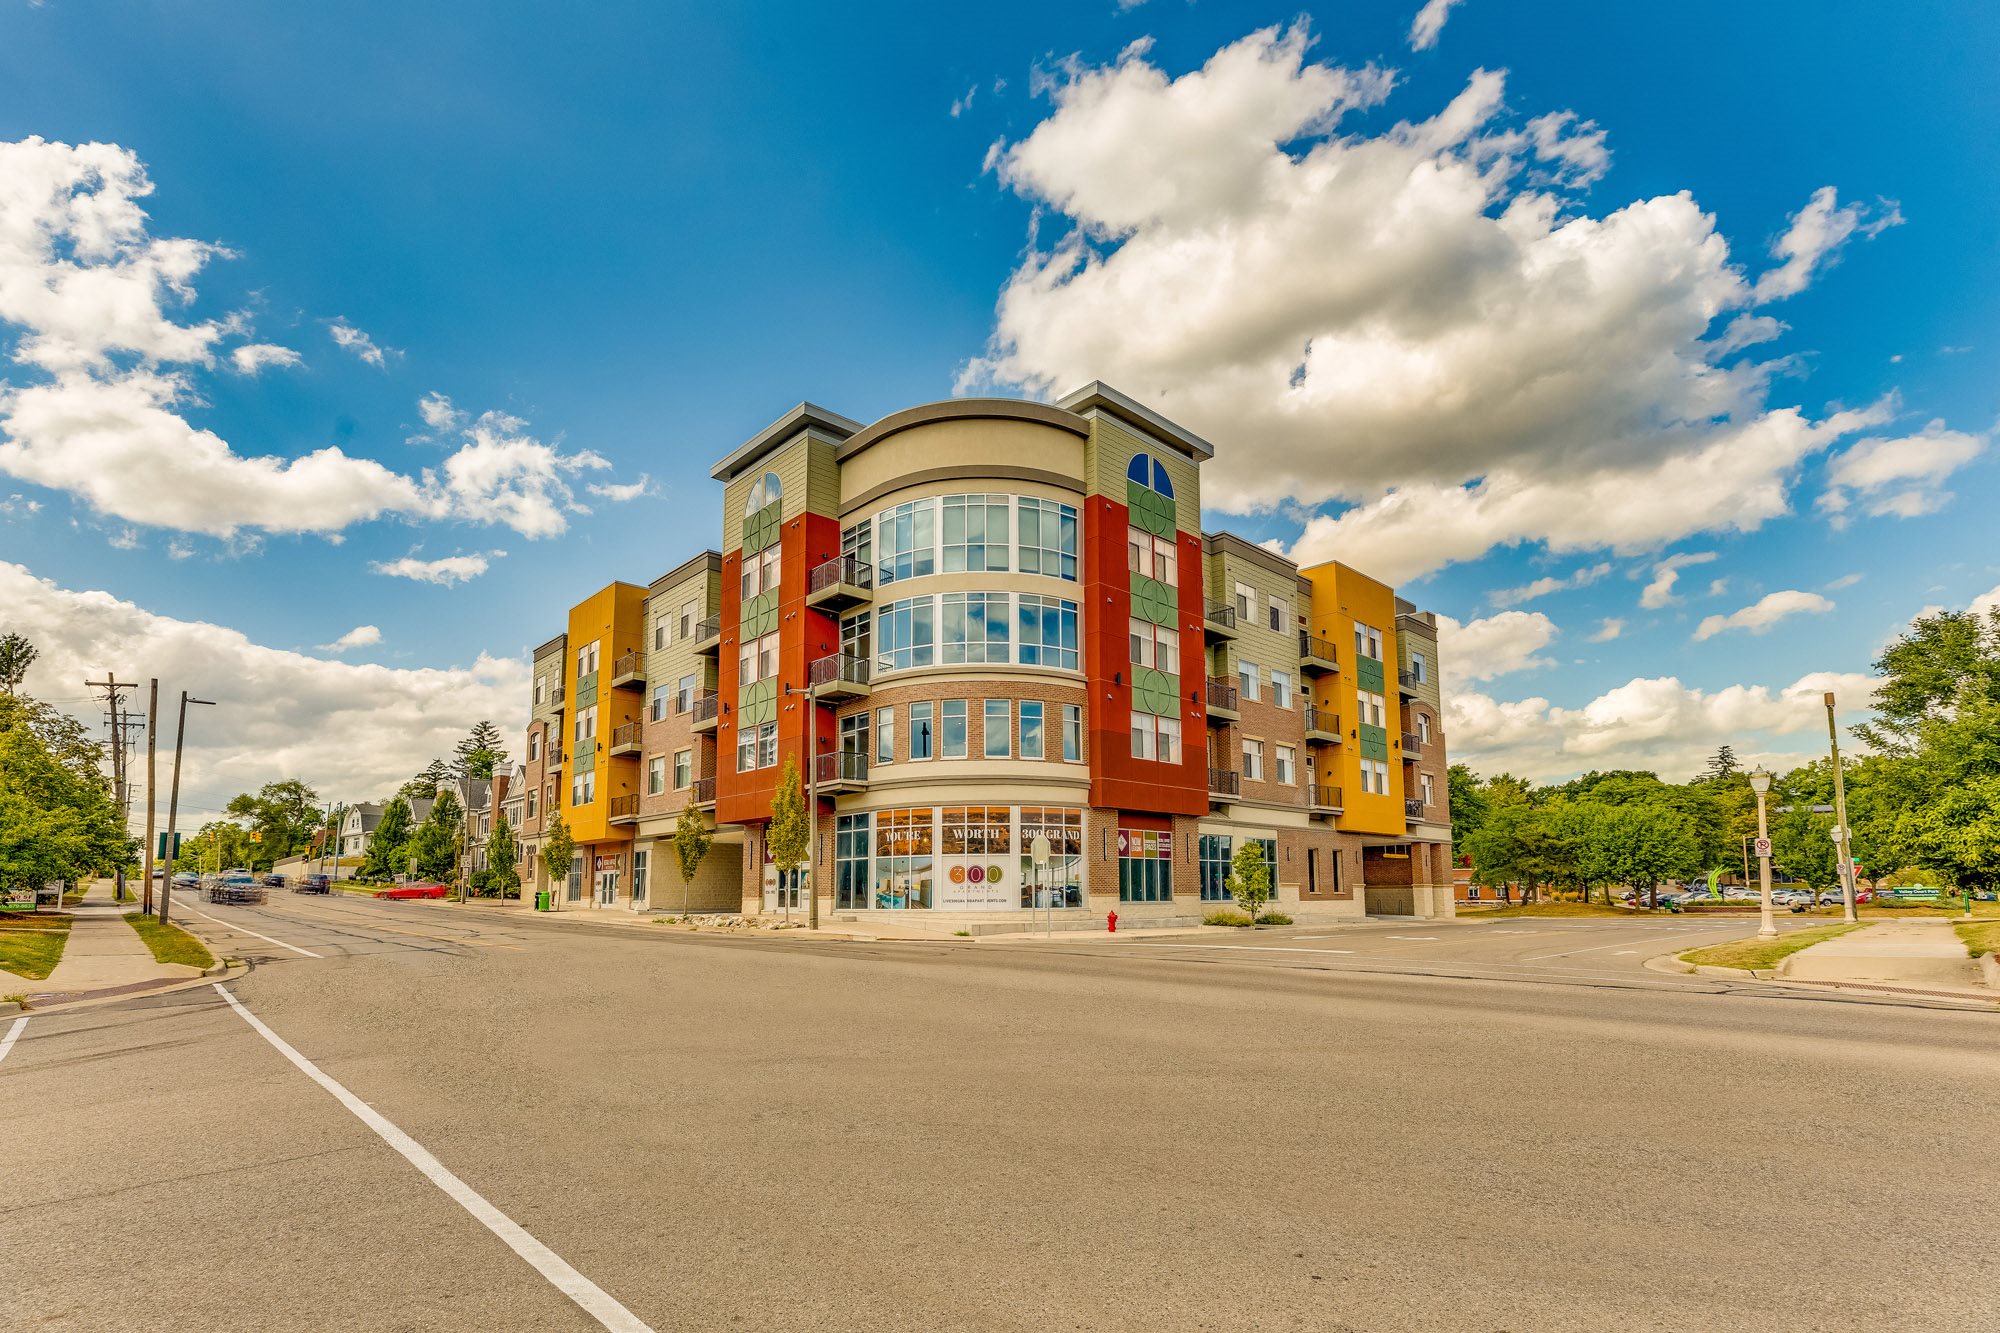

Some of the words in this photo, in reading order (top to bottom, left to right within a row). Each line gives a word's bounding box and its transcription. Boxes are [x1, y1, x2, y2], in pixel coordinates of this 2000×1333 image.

[885, 830, 921, 841] YOU'RE
[953, 829, 1000, 839] WORTH
[1046, 829, 1080, 840] GRAND
[953, 867, 998, 882] 300
